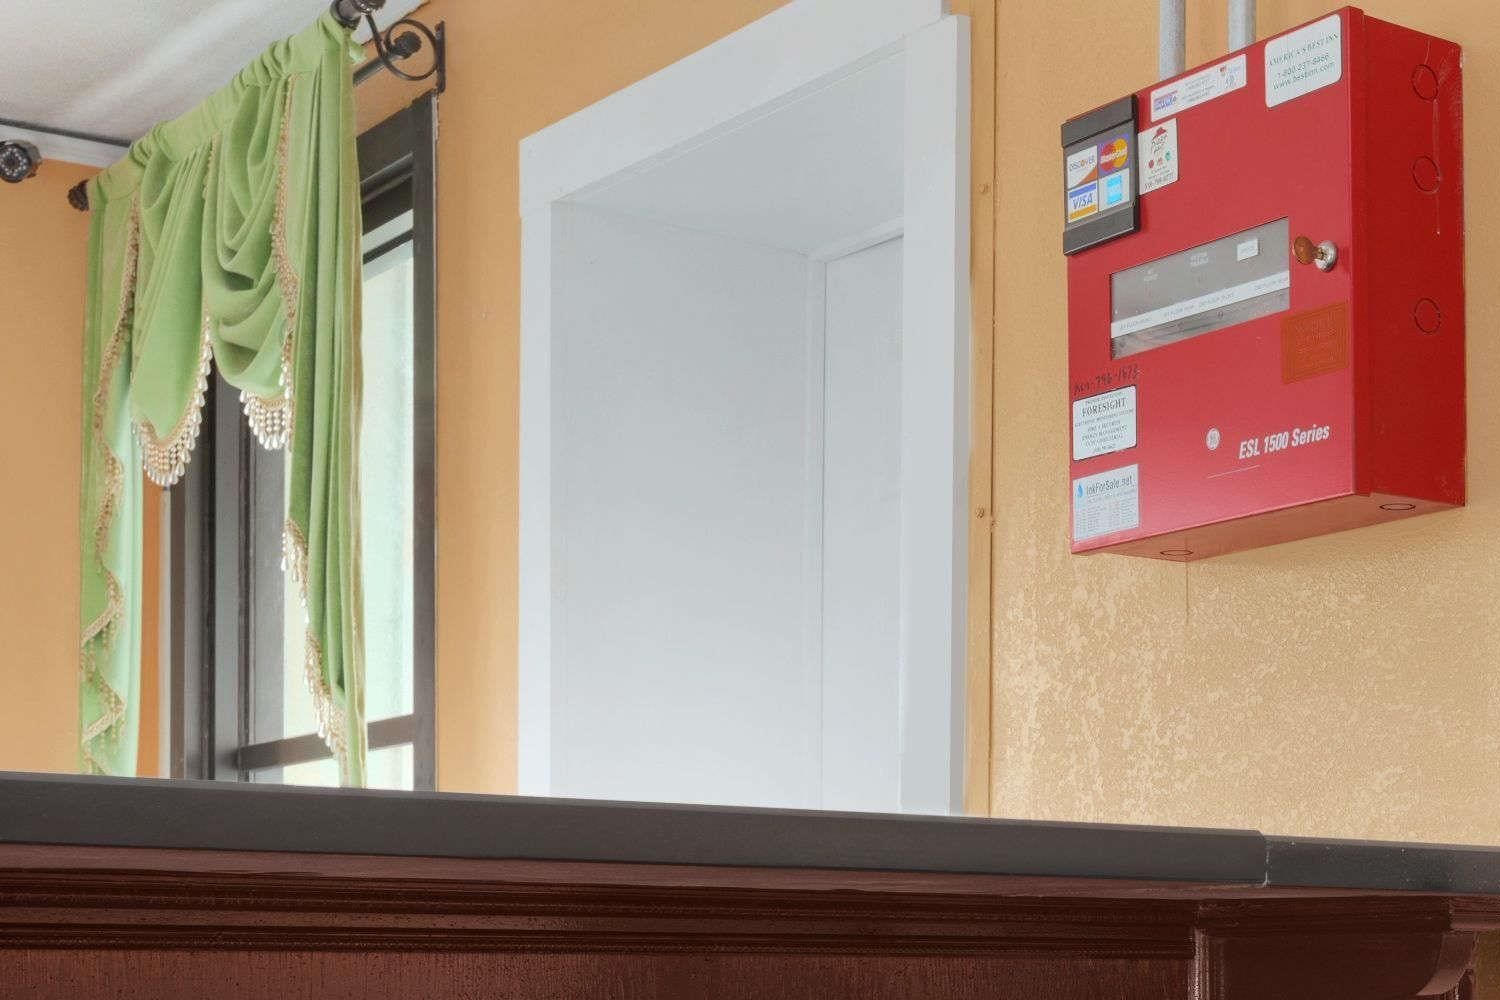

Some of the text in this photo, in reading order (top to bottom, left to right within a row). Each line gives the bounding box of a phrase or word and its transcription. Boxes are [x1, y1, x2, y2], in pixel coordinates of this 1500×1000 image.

[1073, 192, 1094, 210] VISA
[1081, 397, 1127, 418] FORESIGHT
[1239, 438, 1260, 460] ESL
[1263, 431, 1290, 453] 1500
[1292, 424, 1330, 447] Series
